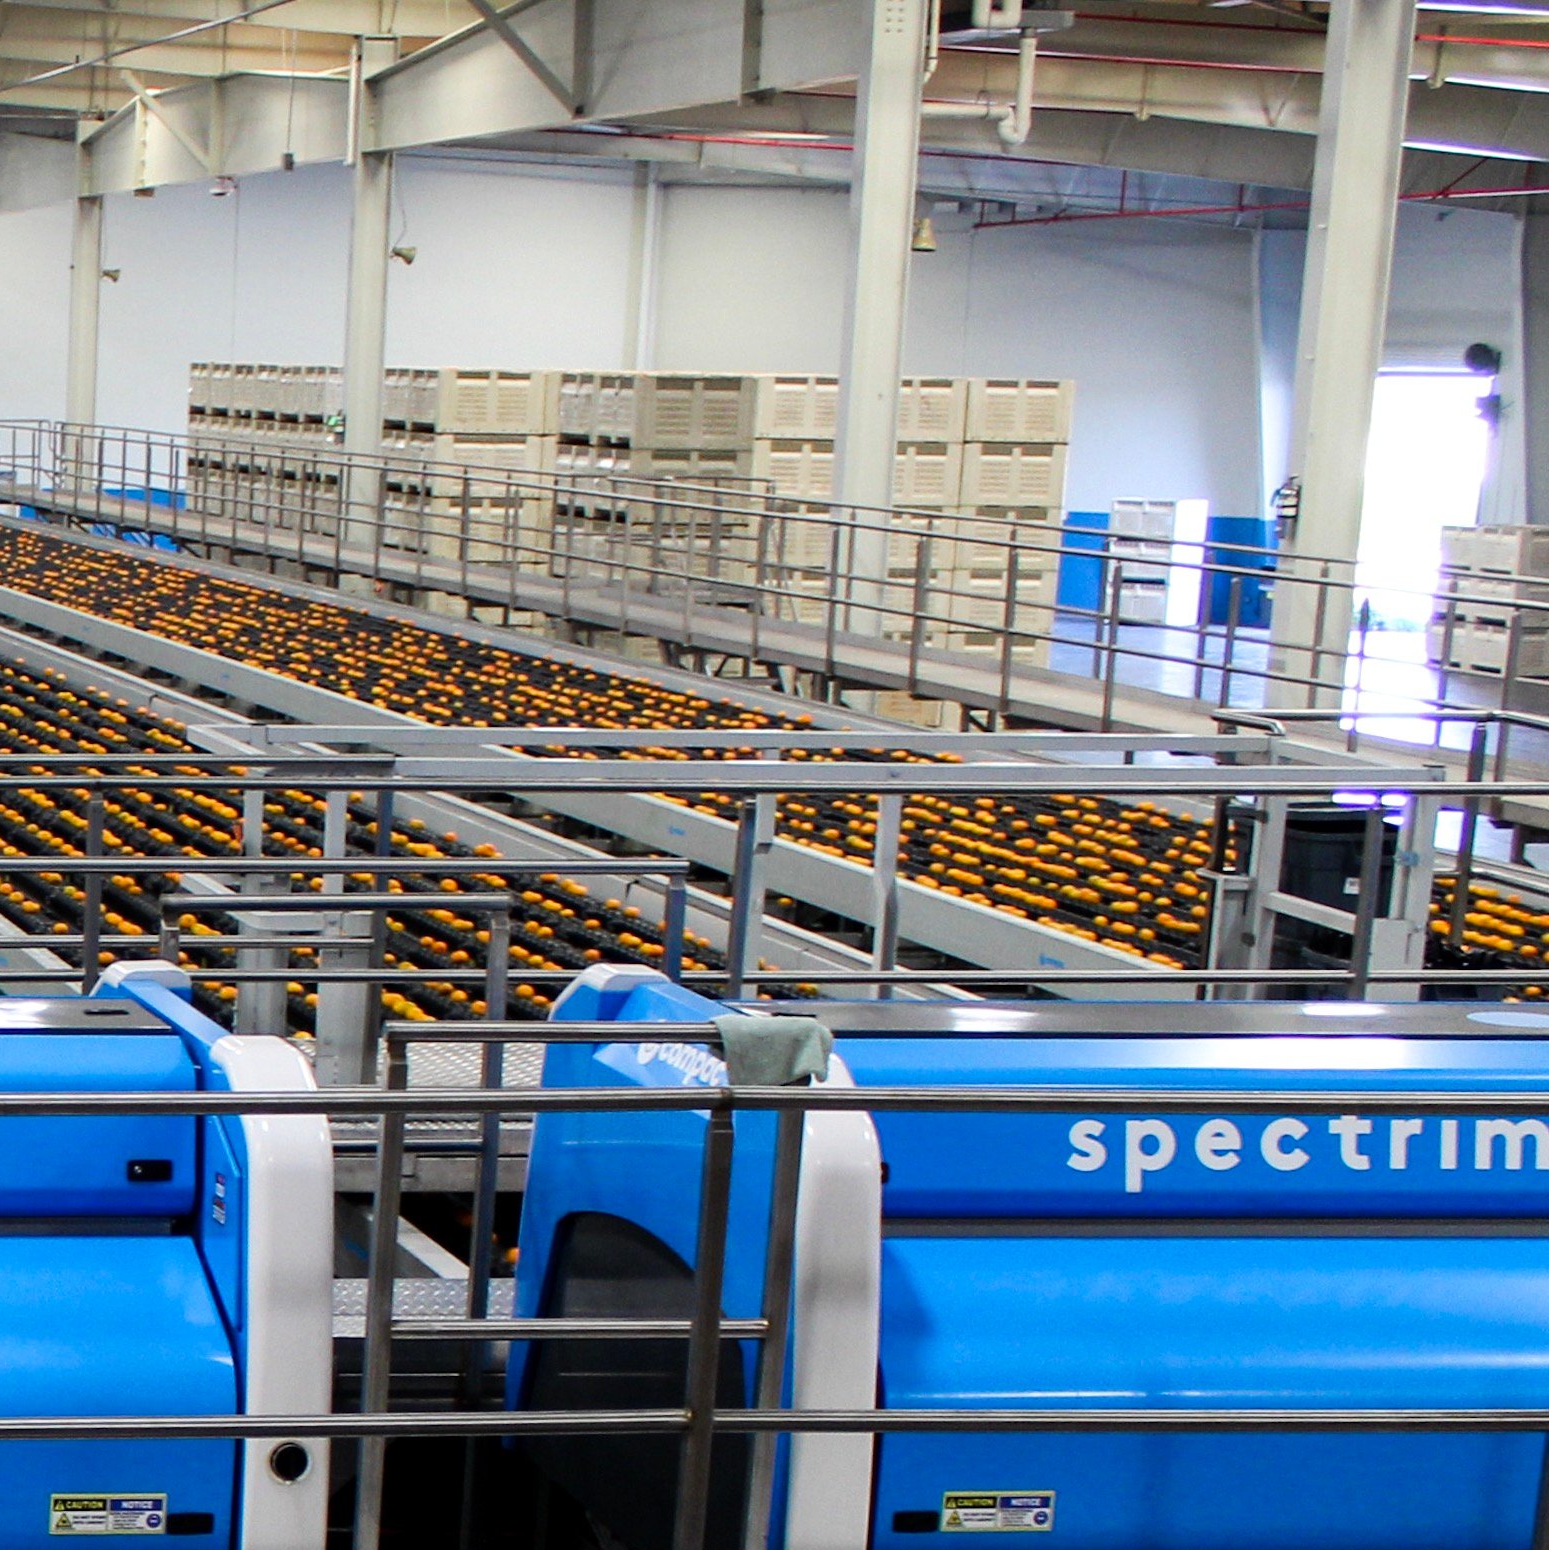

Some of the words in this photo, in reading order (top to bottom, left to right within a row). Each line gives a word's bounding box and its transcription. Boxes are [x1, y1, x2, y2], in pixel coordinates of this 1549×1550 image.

[1066, 1114, 1549, 1193] spectrim
[65, 1500, 104, 1509] CAUTION
[121, 1500, 154, 1509] NOTICE
